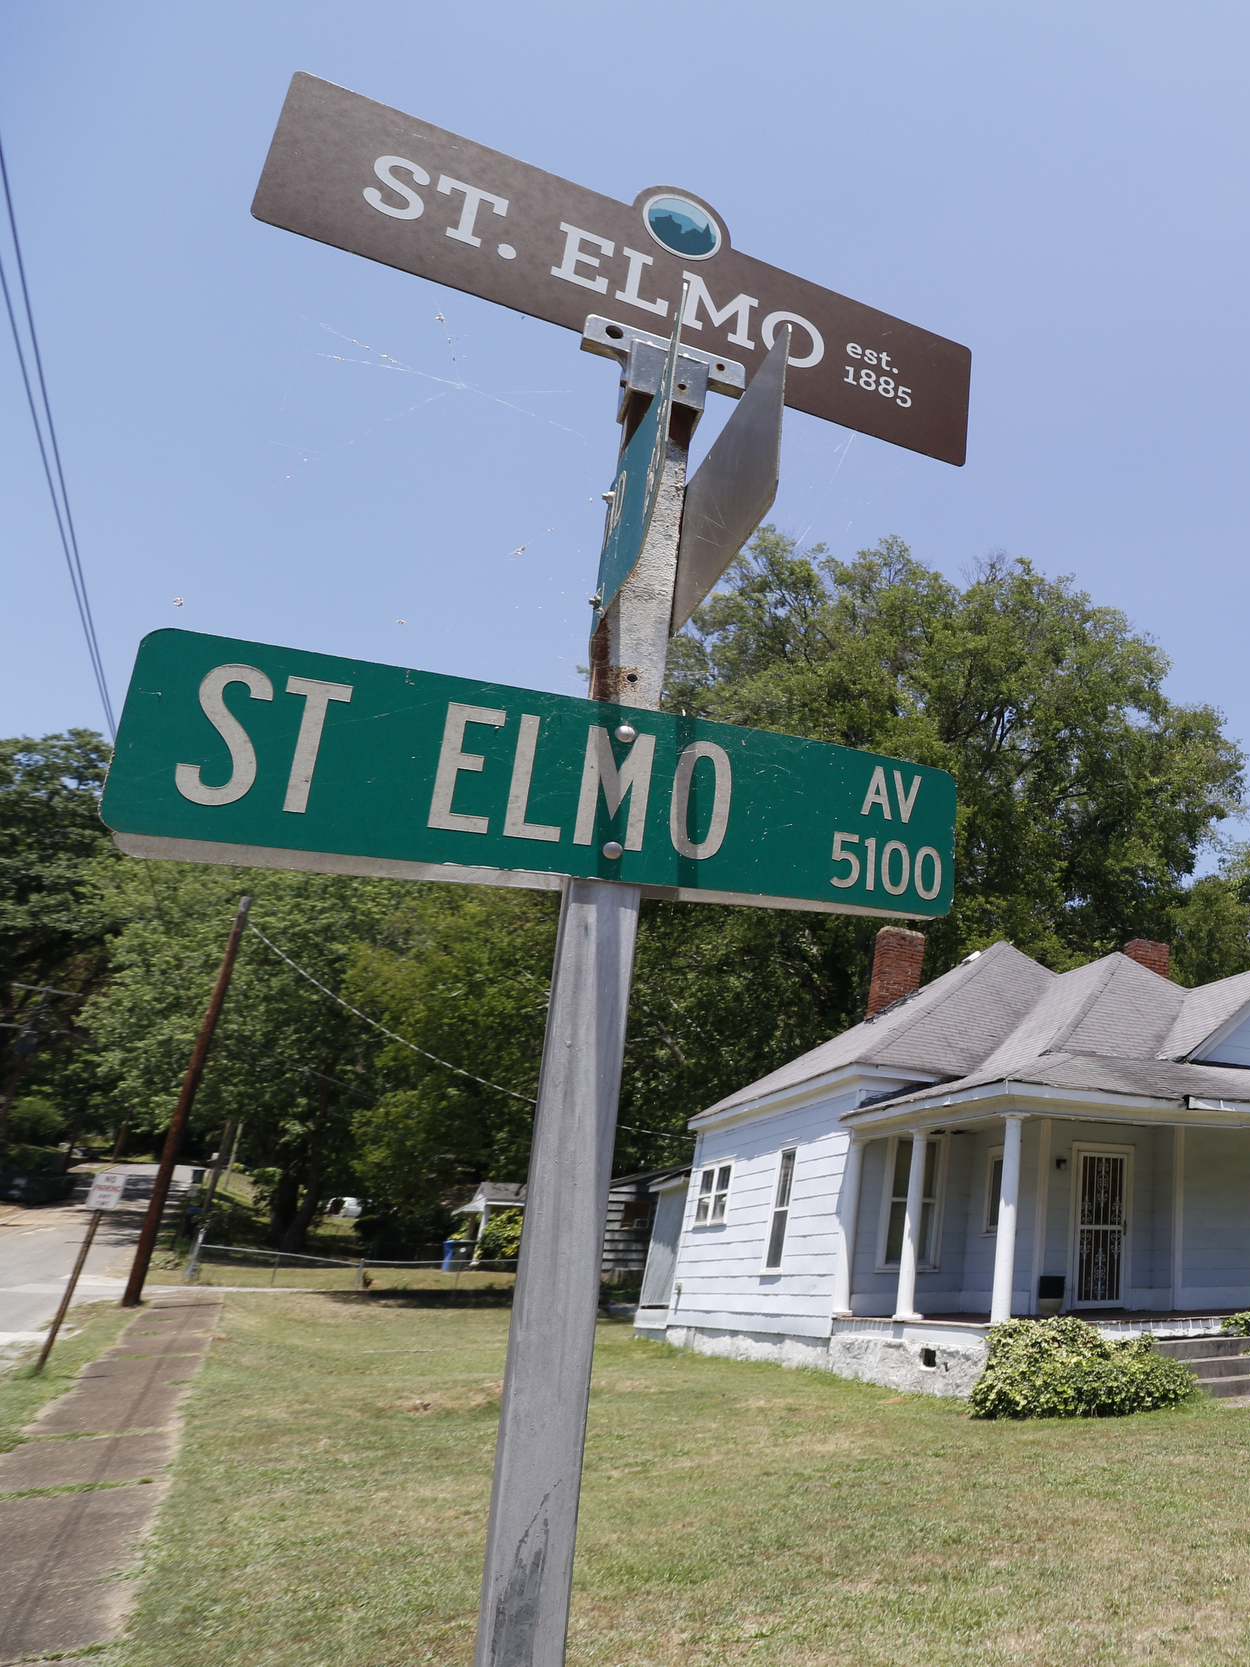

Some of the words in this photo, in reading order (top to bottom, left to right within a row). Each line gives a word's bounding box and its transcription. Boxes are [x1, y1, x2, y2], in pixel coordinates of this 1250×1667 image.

[362, 155, 517, 260] ST.
[550, 221, 825, 368] ELMO
[843, 366, 912, 408] 1885
[846, 342, 899, 374] est.
[174, 663, 354, 813] ST
[427, 701, 732, 860] ELMO
[860, 765, 922, 824] AV
[829, 831, 942, 900] 5100
[93, 1184, 122, 1193] PARKING
